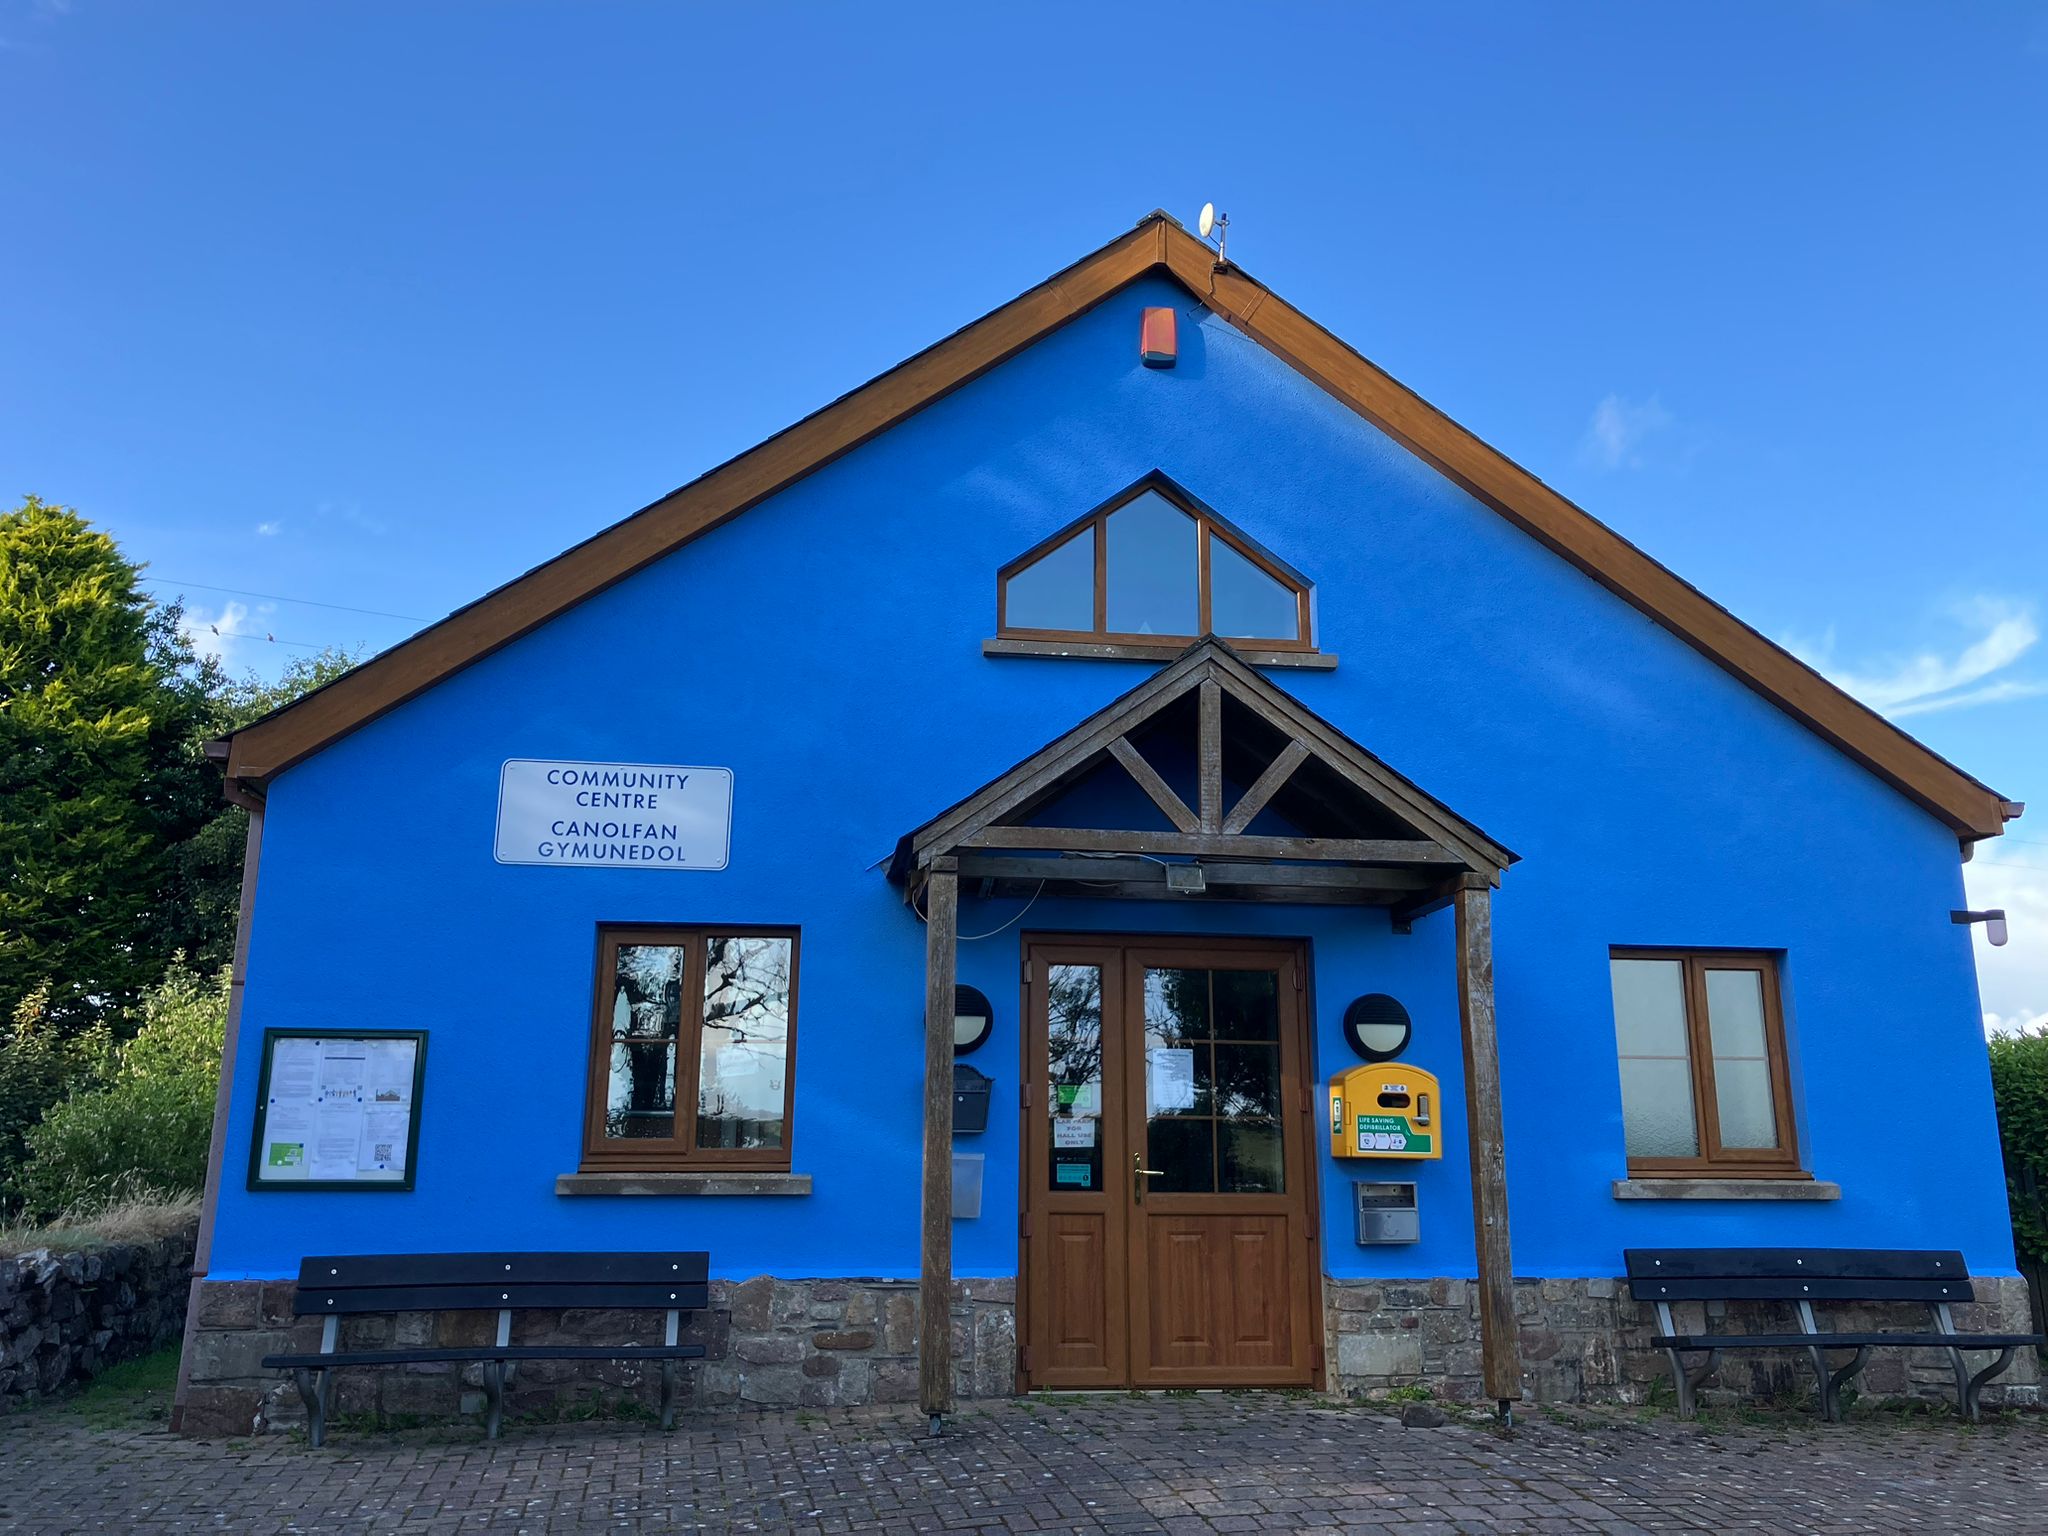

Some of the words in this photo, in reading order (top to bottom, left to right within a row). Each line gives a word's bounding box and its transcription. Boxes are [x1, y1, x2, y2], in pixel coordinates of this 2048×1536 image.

[547, 769, 689, 790] COMMUNITY
[576, 791, 658, 809] CENTRE
[551, 821, 677, 840] CANOLFAN
[538, 842, 686, 862] GYMUNEDOL
